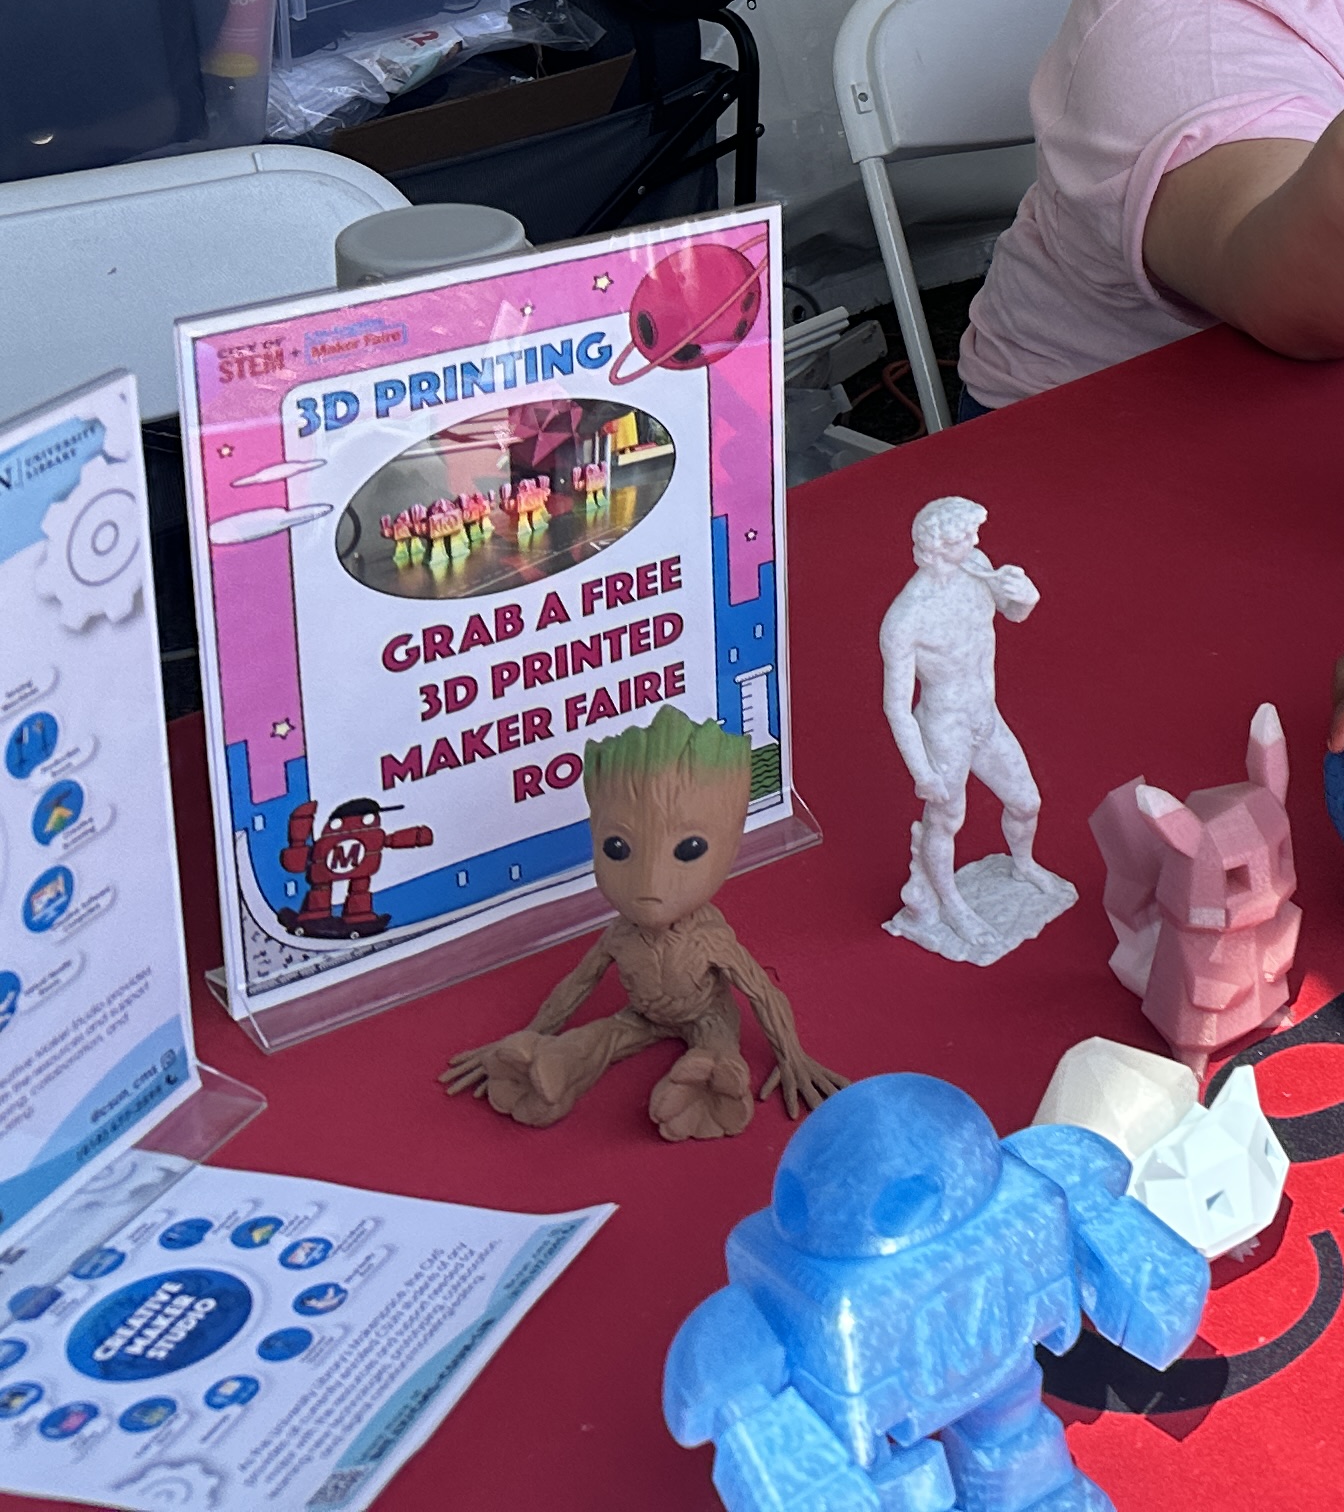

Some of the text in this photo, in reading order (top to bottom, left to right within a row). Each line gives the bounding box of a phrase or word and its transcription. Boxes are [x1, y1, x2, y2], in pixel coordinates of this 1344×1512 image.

[219, 347, 286, 384] STEM
[311, 338, 359, 358] Maker
[297, 331, 613, 438] 3D PRINTING
[24, 425, 95, 467] UNIVERSITY
[25, 447, 76, 480] LIBRARY
[381, 555, 682, 673] GRAB A FREE
[419, 612, 684, 722] 3D PRINTED
[381, 661, 686, 791] MAKER FAIRE
[513, 752, 584, 804] RO
[331, 843, 363, 870] M
[92, 1280, 186, 1362] CREATIVE
[124, 1294, 197, 1356] MAKER
[146, 1297, 218, 1360] STUDIO
